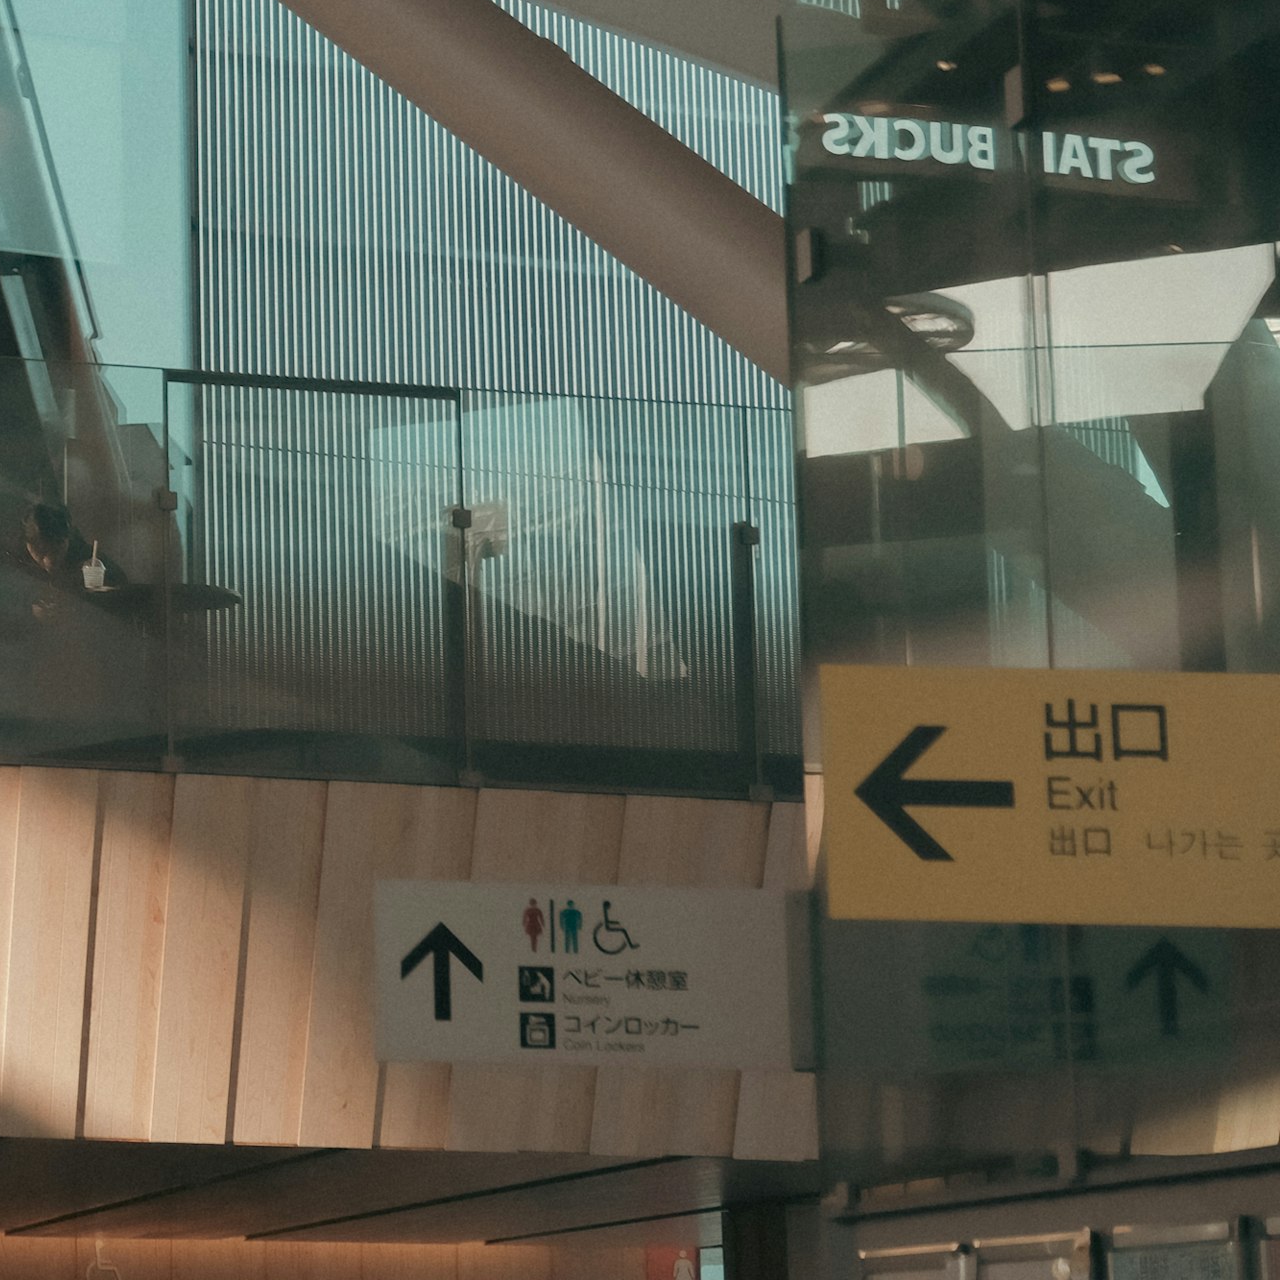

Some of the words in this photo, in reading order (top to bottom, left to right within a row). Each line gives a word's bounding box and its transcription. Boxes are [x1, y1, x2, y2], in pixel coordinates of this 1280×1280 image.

[1044, 698, 1169, 762] 出口
[1047, 776, 1119, 811] Exit
[1049, 826, 1111, 856] 出口
[1146, 827, 1244, 860] 나가는
[562, 968, 689, 991] ベビー休憩室
[562, 993, 610, 1007] Nursery
[563, 1015, 700, 1036] コインロッカー
[563, 1039, 592, 1051] Coin
[595, 1040, 645, 1053] Lockers
